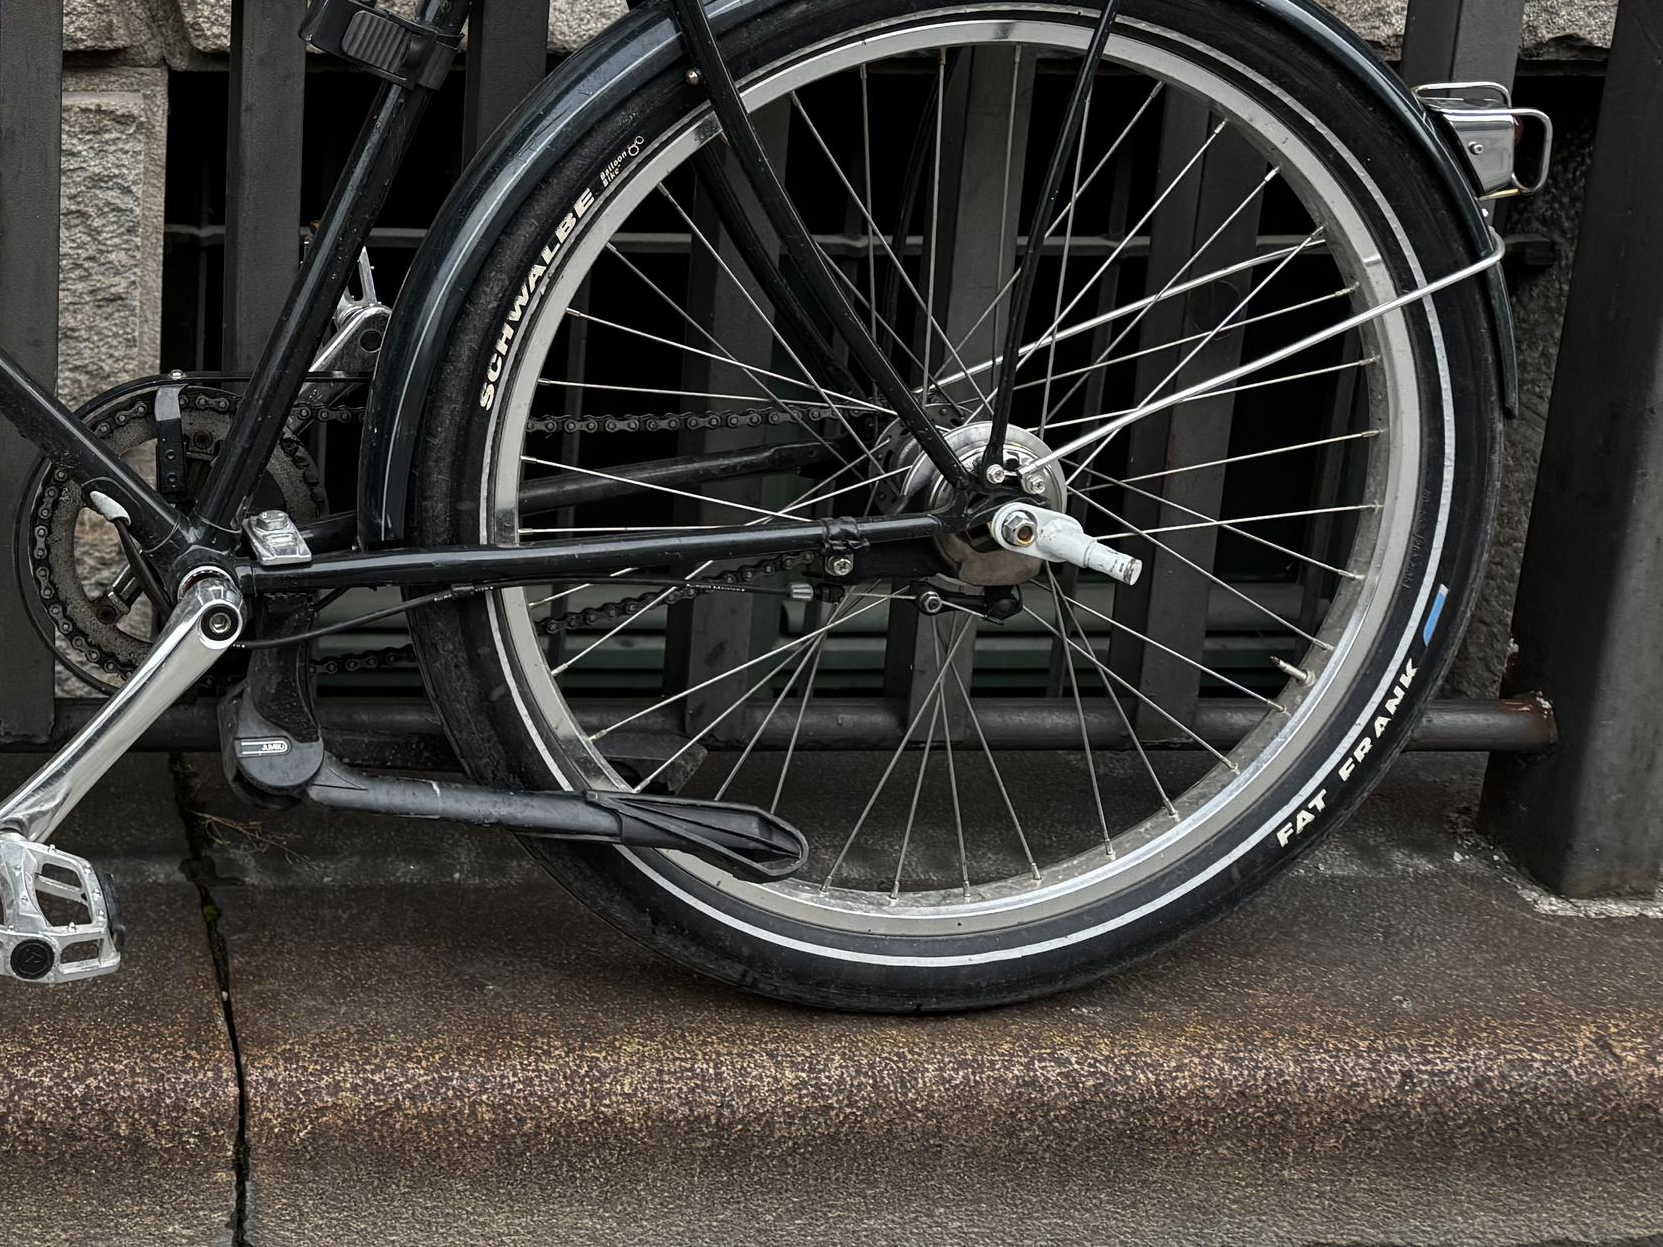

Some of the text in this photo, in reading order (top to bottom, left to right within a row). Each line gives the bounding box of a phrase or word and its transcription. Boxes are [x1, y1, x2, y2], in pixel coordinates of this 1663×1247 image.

[480, 187, 595, 411] SCHWALBE
[1276, 788, 1328, 848] FAT
[1338, 657, 1419, 782] FRANK
